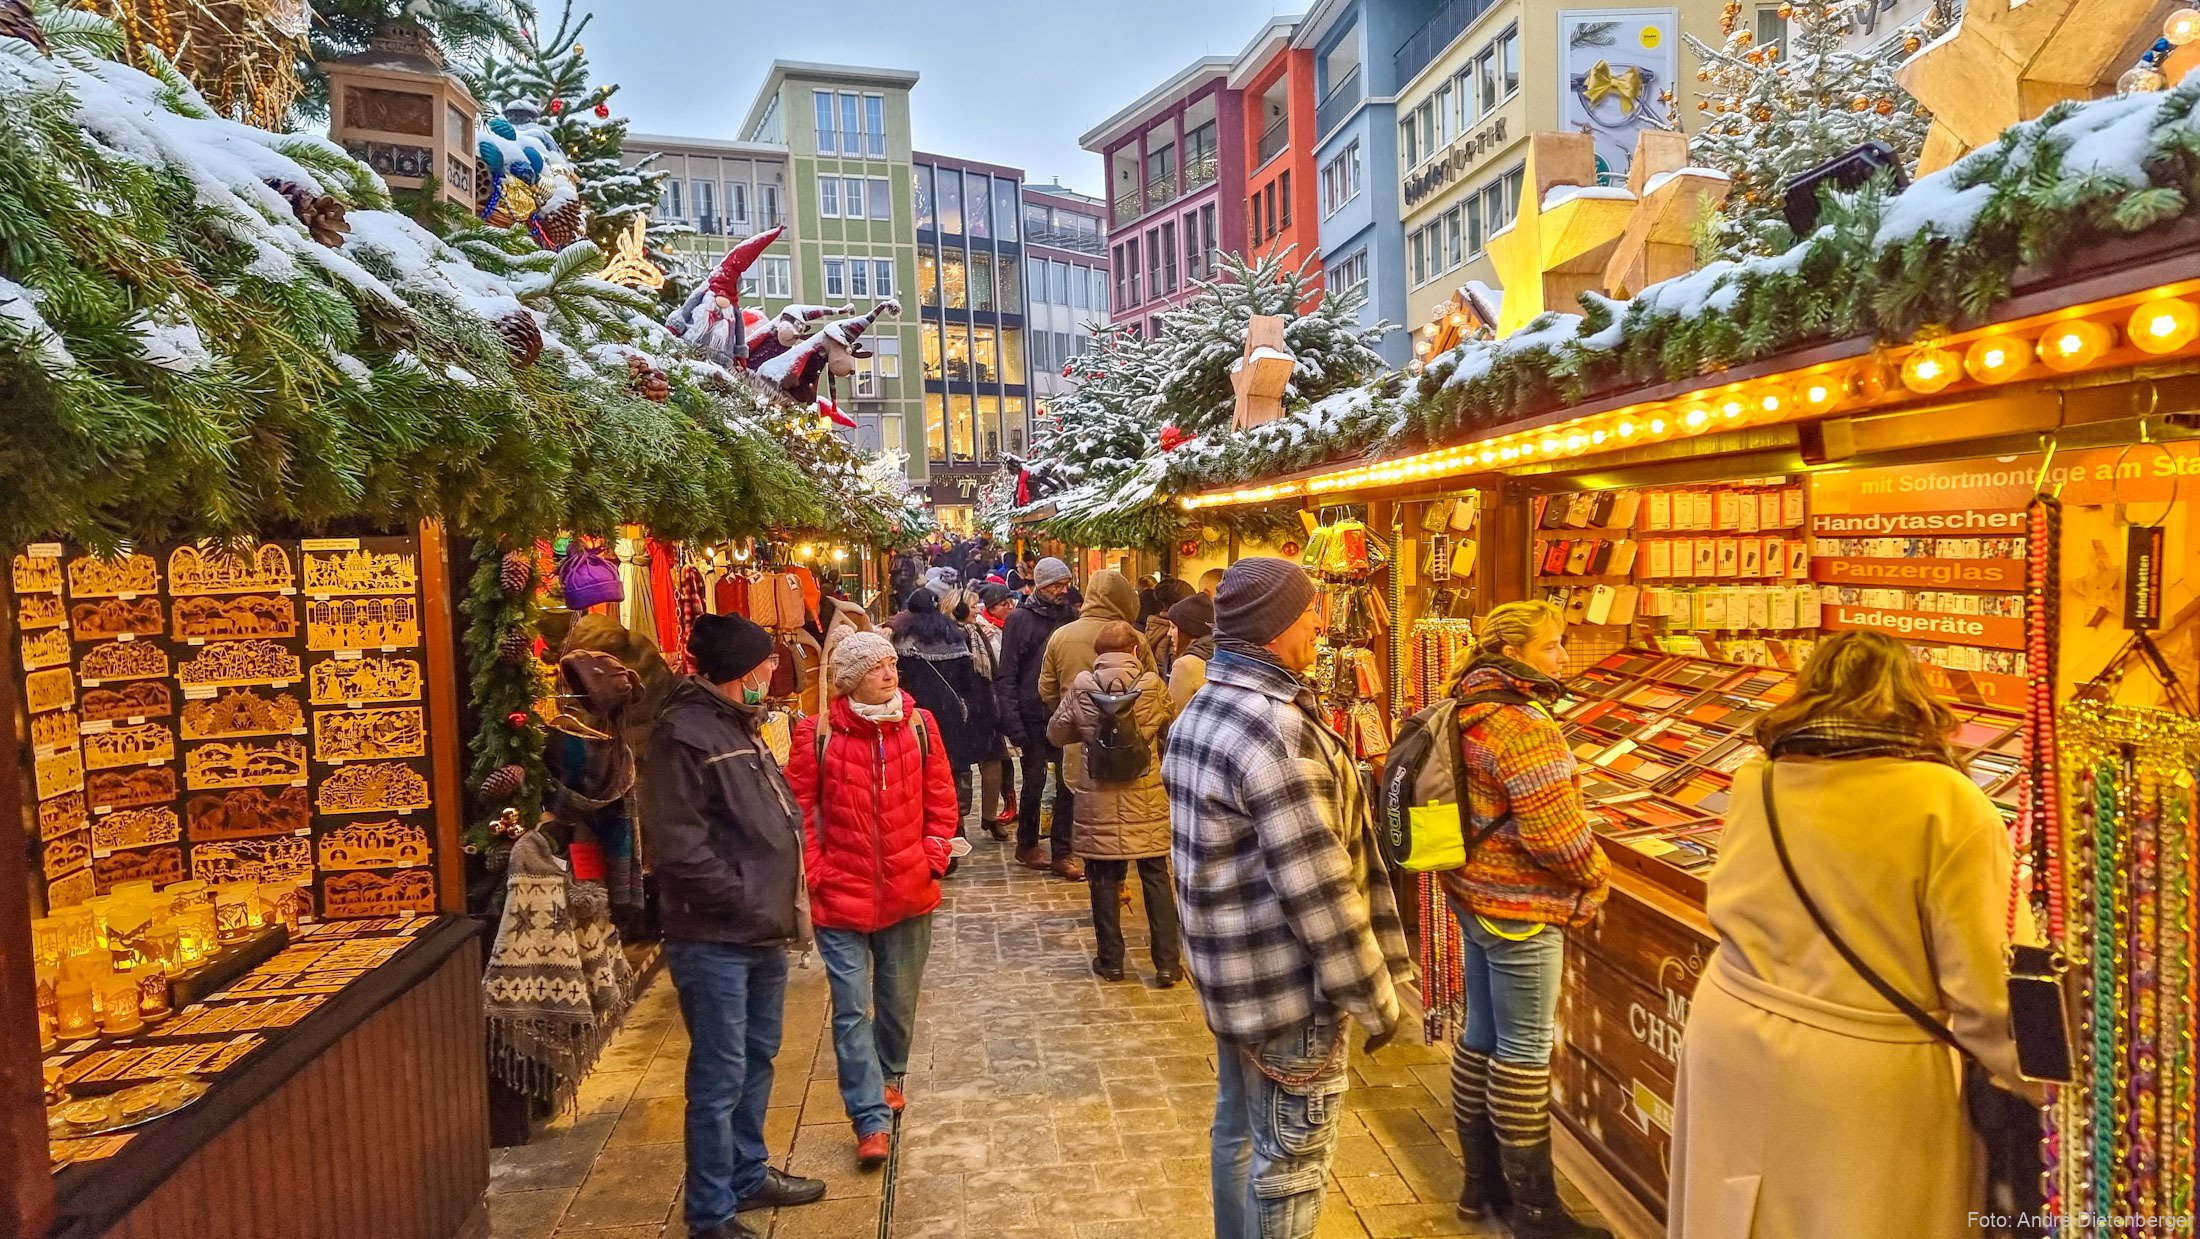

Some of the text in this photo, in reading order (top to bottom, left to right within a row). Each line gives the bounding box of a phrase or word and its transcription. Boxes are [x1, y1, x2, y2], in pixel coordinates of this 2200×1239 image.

[1861, 475, 1893, 494] mit
[2095, 461, 2141, 480] am
[1831, 561, 2004, 584] Panzerglas
[2135, 554, 2150, 618] Handyketten
[1838, 608, 1984, 636] Ladegeräte
[1665, 987, 1692, 1027] M
